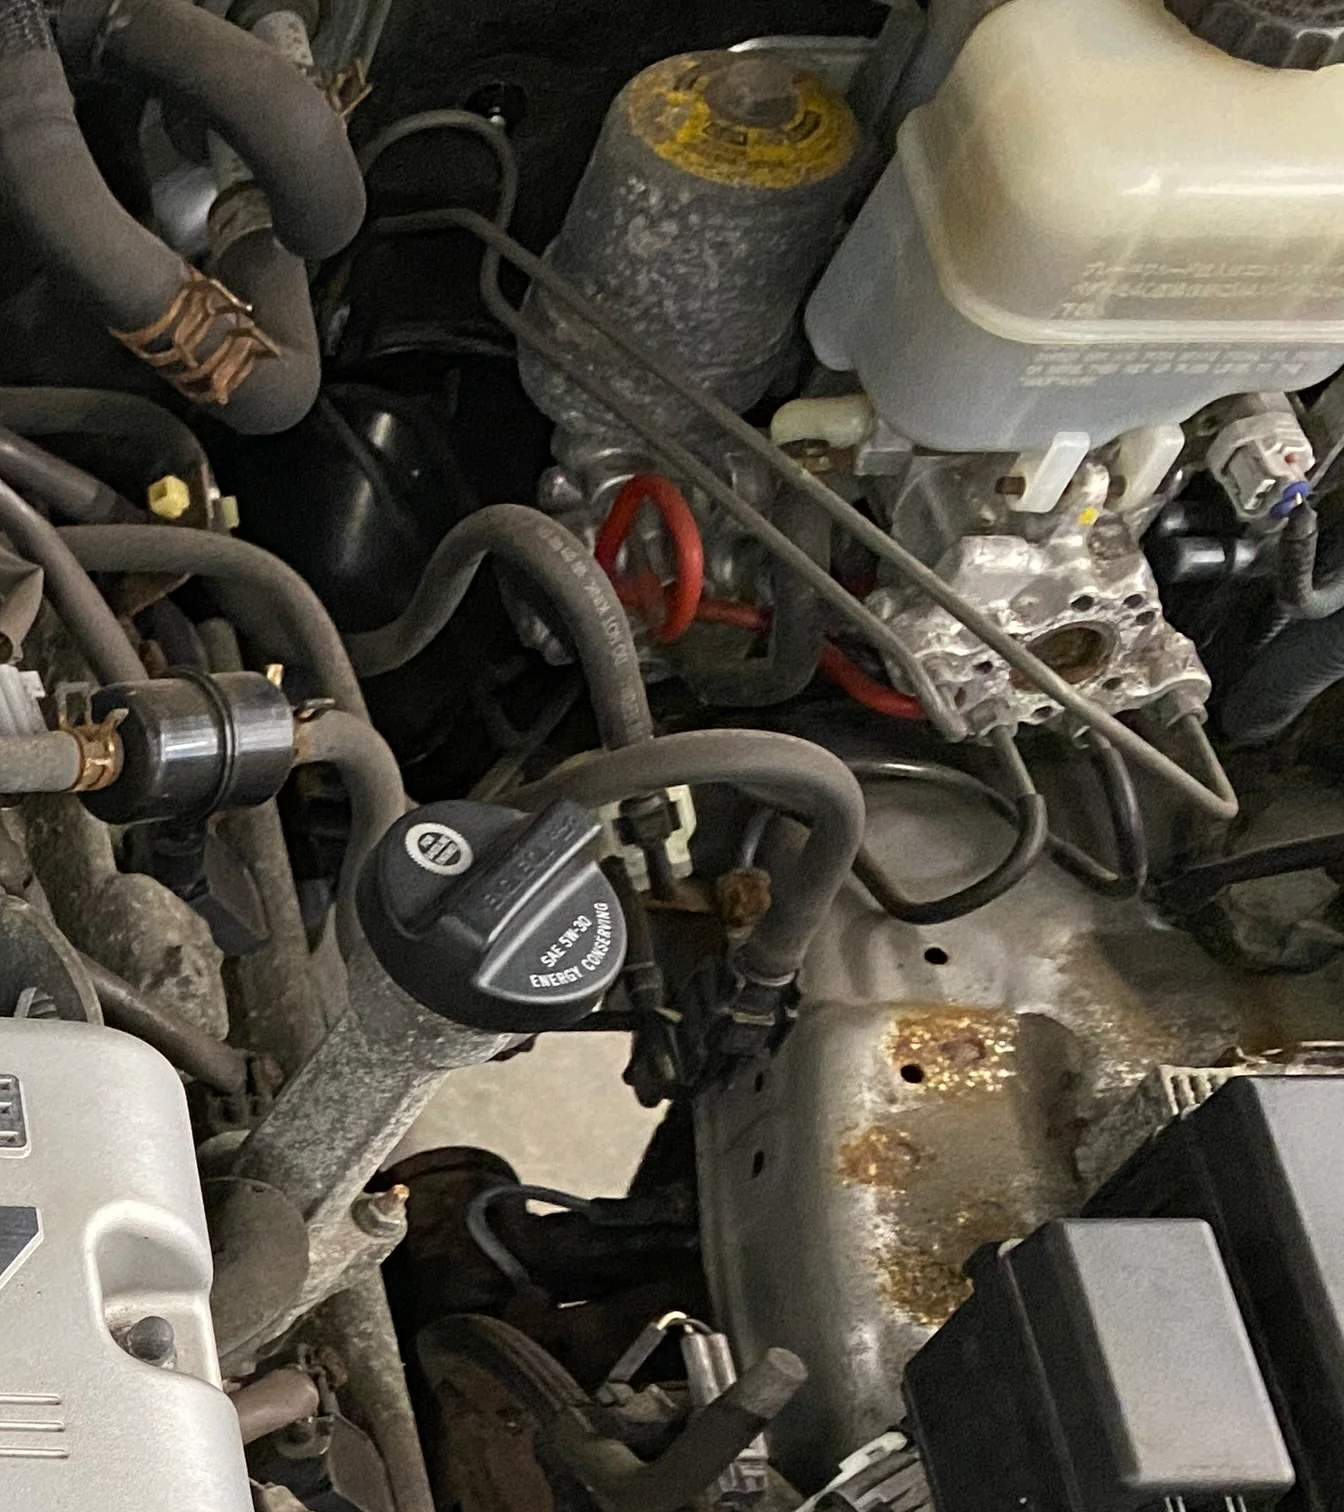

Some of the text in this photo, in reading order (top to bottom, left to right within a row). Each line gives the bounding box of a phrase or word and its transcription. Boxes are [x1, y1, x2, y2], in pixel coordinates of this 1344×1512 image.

[529, 902, 611, 988] ENERGY CONSERVING
[540, 915, 593, 968] SAE 5W-30
